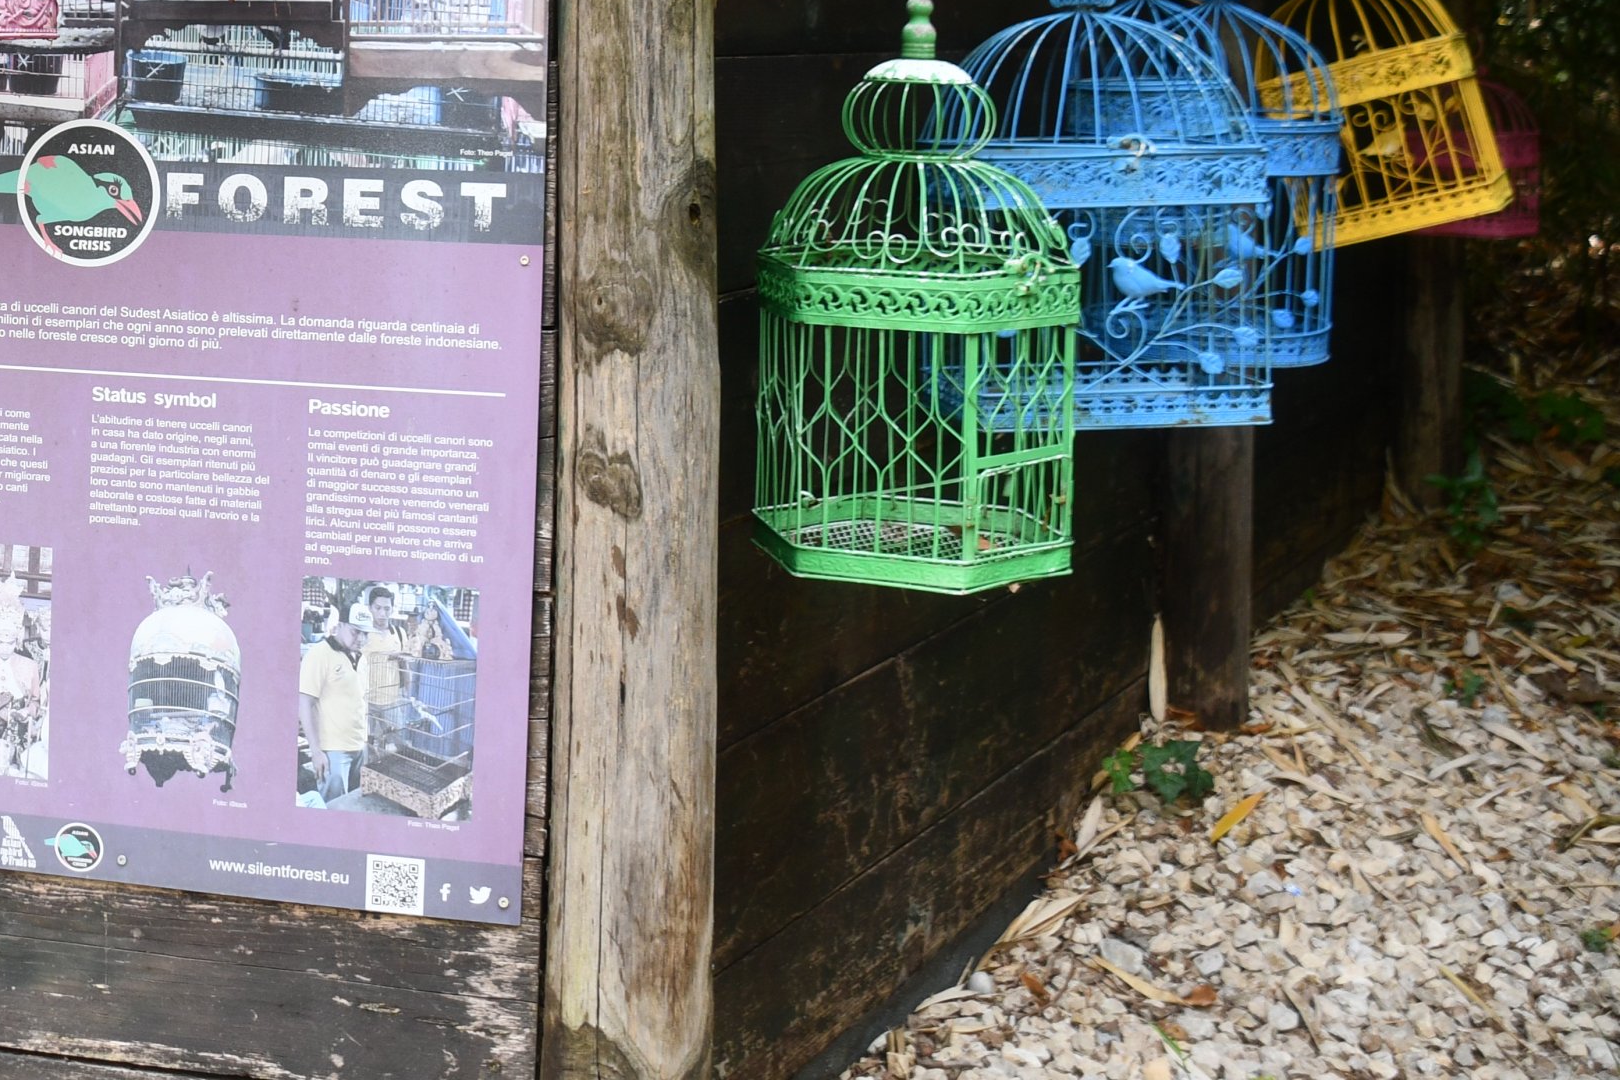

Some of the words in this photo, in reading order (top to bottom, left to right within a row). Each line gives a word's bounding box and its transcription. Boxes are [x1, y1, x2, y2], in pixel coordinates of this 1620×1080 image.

[68, 144, 115, 155] ASIAN
[166, 172, 506, 233] FOREST
[54, 225, 127, 238] SONGBIRD
[69, 240, 111, 251] CRISIS
[10, 300, 21, 312] di
[24, 302, 59, 314] uccelli
[62, 304, 97, 316] canori
[100, 305, 117, 317] del
[120, 306, 161, 319] Sudest
[162, 308, 209, 321] Asiatico
[211, 310, 219, 322] è
[222, 311, 276, 325] altissima.
[280, 313, 296, 326] La
[298, 314, 354, 328] domanda
[358, 317, 407, 334] riguarda
[410, 320, 465, 334] centinaia
[468, 323, 480, 335] di
[8, 327, 36, 339] nelle
[38, 328, 77, 342] foreste
[80, 333, 118, 344] cresce
[121, 334, 146, 348] ogni
[148, 334, 185, 348] giorno
[188, 336, 198, 348] di
[201, 337, 222, 350] più.
[32, 315, 42, 327] di
[44, 316, 100, 332] esemplari
[103, 318, 124, 331] che
[127, 320, 151, 335] ogni
[154, 324, 184, 334] anno
[186, 325, 215, 335] sono
[218, 324, 268, 339] prelevati
[271, 326, 346, 342] direttamente
[348, 330, 377, 343] dalle
[380, 332, 422, 345] foreste
[425, 334, 502, 349] indonesiane.
[92, 387, 146, 404] Status
[154, 392, 217, 408] symbol
[4, 410, 31, 418] come
[308, 399, 390, 418] Passione
[144, 417, 154, 427] di
[156, 418, 187, 428] tenere
[189, 421, 220, 430] uccelli
[222, 423, 252, 432] canori
[20, 434, 43, 444] nella
[91, 427, 100, 436] in
[102, 430, 125, 438] casa
[127, 429, 140, 439] ha
[142, 430, 164, 440] dato
[166, 431, 201, 444] origine,
[204, 434, 228, 446] negli
[308, 428, 321, 437] Le
[323, 428, 386, 442] competizioni
[388, 432, 398, 442] di
[400, 434, 432, 444] uccelli
[434, 436, 466, 446] canori
[468, 439, 494, 447] sono
[307, 442, 336, 451] ormai
[338, 444, 369, 453] eventi
[371, 444, 380, 454] di
[382, 446, 418, 457] grande
[421, 447, 480, 461] importanza.
[308, 453, 314, 462] Il
[316, 454, 358, 465] vincitore
[360, 457, 380, 467] può
[382, 457, 442, 472] guadagnare
[444, 462, 477, 473] grandi
[209, 858, 349, 885] www.silentforest.eu
